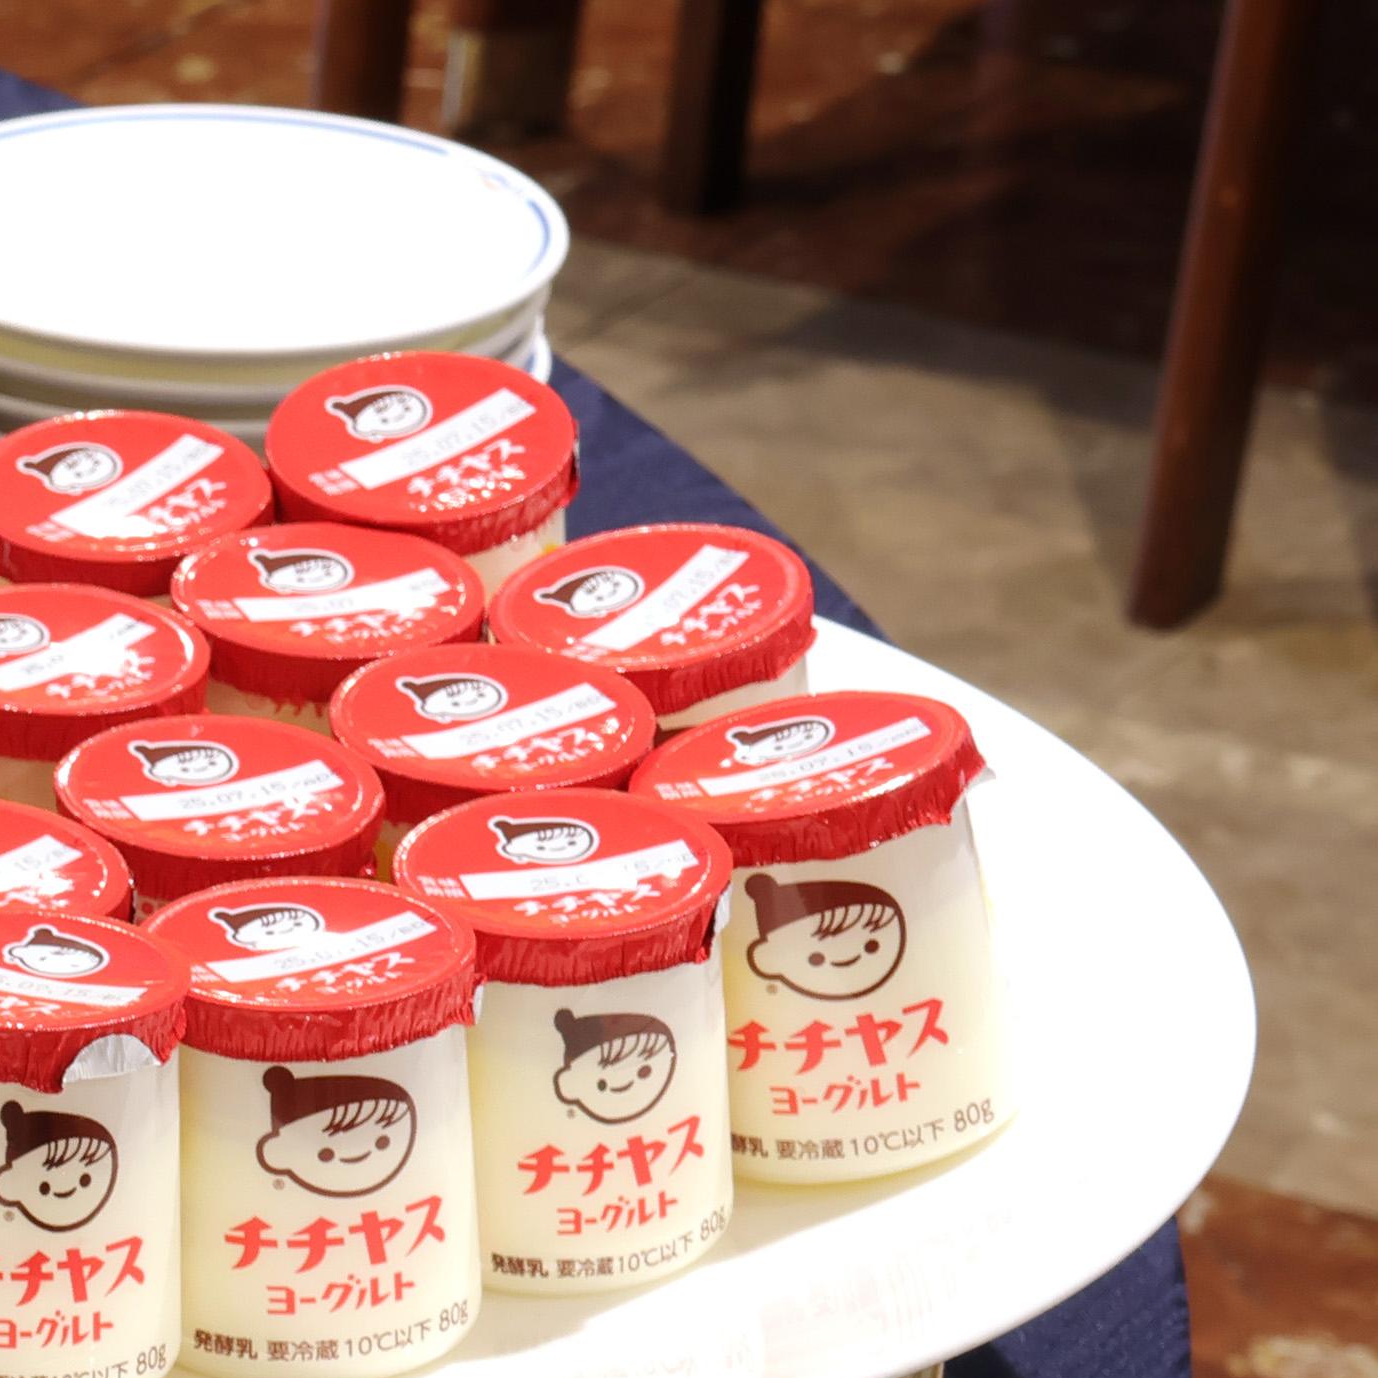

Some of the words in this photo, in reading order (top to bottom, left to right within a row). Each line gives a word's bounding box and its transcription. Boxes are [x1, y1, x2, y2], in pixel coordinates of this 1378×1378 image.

[727, 997, 950, 1075] チチヤス
[769, 1071, 921, 1116] ヨーグルト
[954, 1097, 995, 1133] 80g
[517, 1114, 705, 1198] チチヤス
[224, 1194, 447, 1274] チチヤス
[491, 1252, 549, 1278] 発酵乳
[700, 1203, 727, 1242] 80g
[556, 1193, 679, 1236] ヨーグルト
[266, 1270, 416, 1317] ヨーグルト
[193, 1328, 258, 1361] 発酵乳
[439, 1300, 469, 1332] 80g
[136, 1343, 167, 1376] 80g
